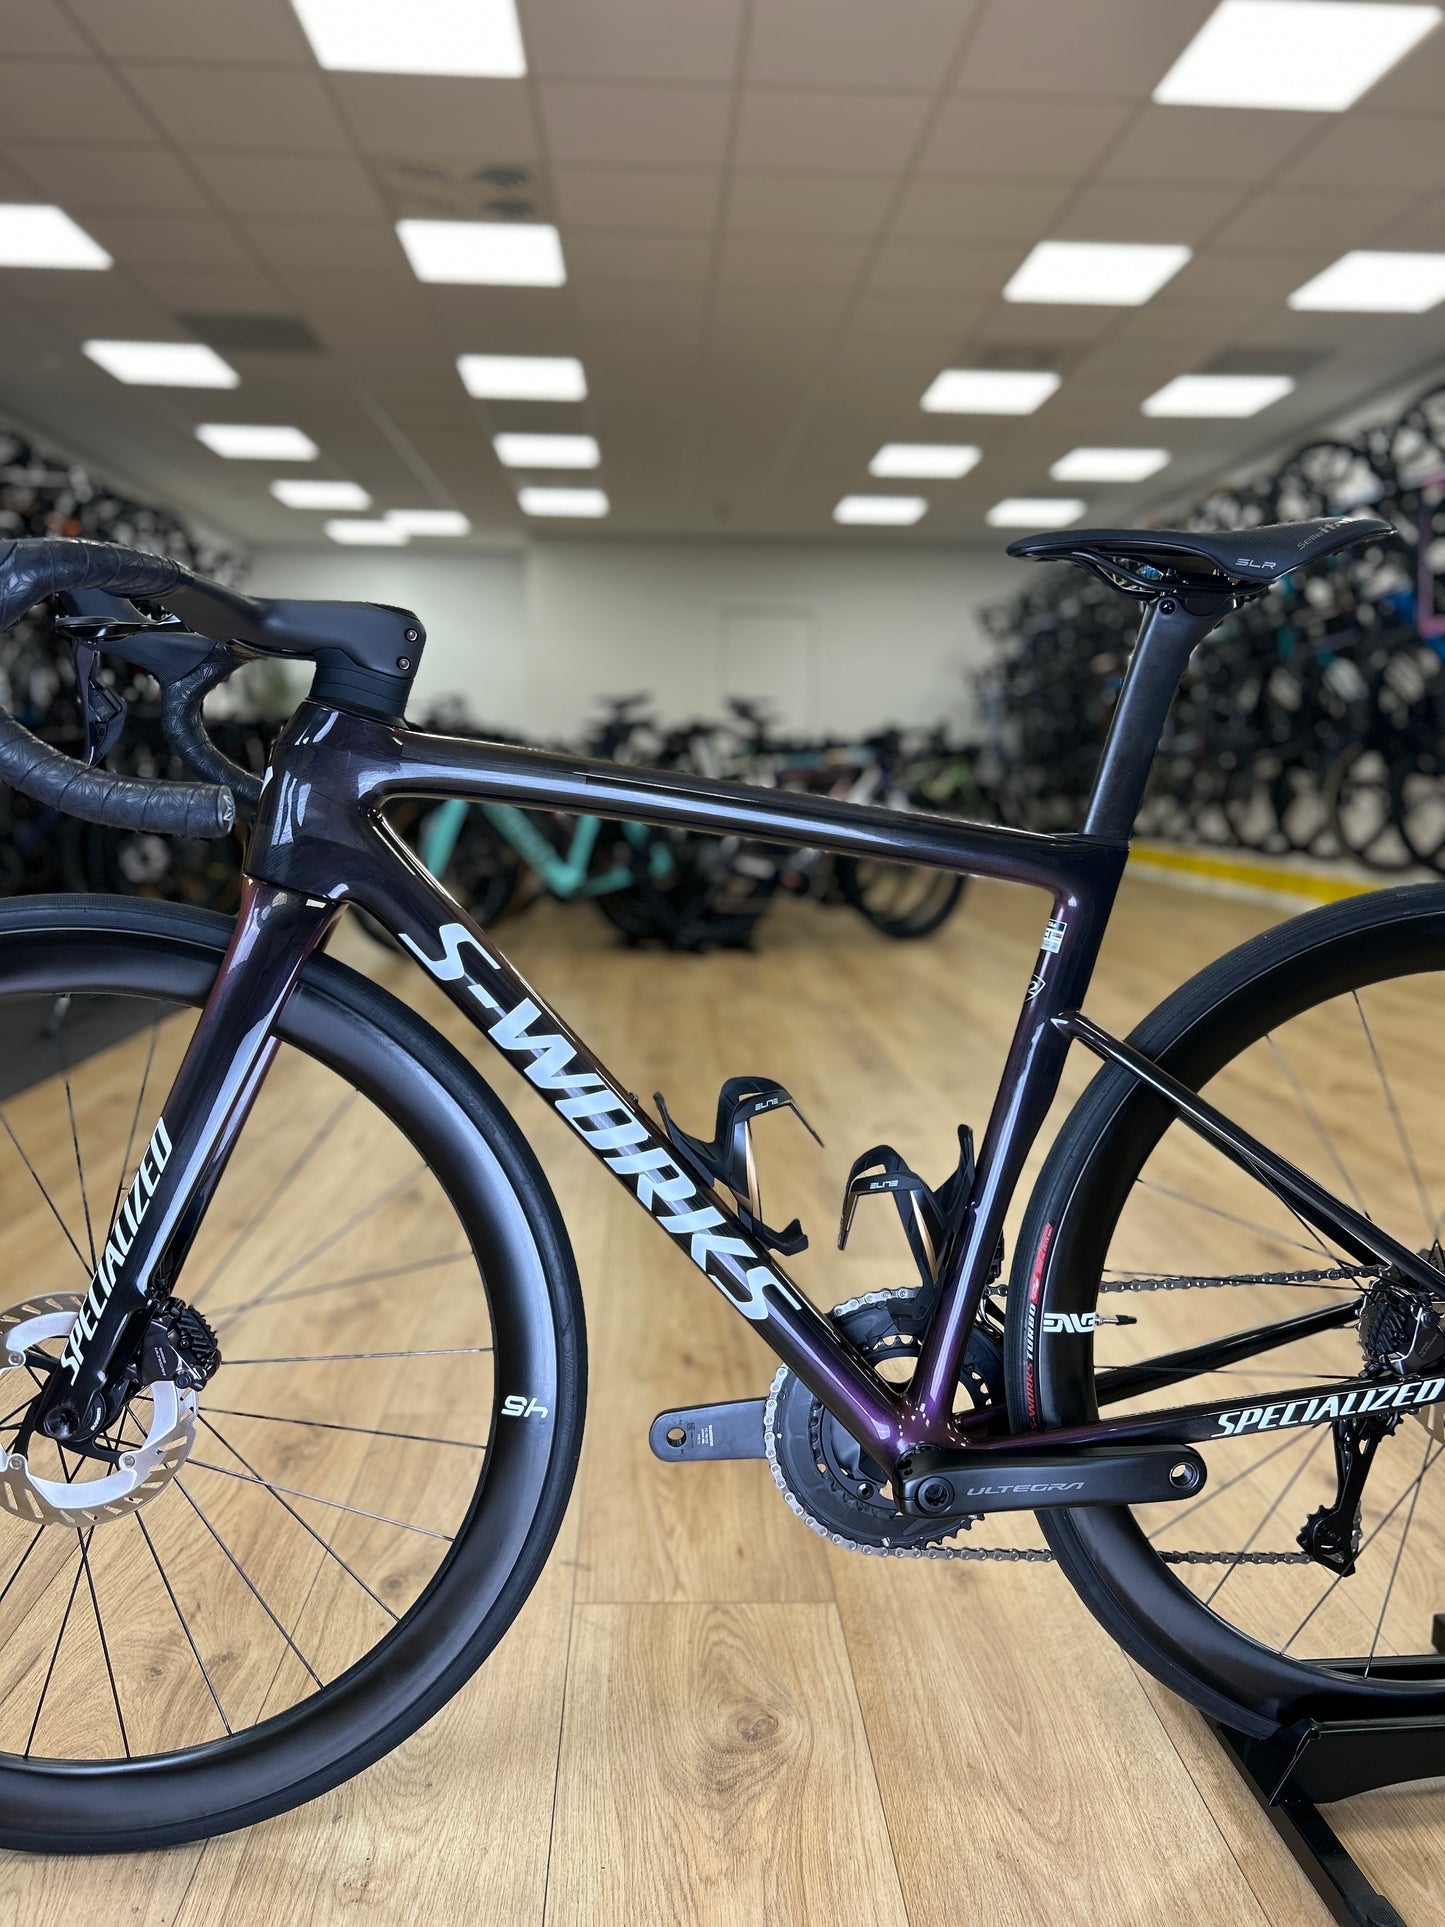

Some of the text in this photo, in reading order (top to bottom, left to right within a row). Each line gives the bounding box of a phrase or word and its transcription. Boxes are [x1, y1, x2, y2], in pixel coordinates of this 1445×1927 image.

[1235, 558, 1277, 570] SLR
[398, 923, 802, 1320] S-WORKS
[60, 1116, 173, 1386] SPECIALIZED
[1025, 1302, 1037, 1361] TURBO
[1024, 1362, 1037, 1430] S-WORKS
[1210, 1377, 1445, 1438] SPECIALIZED
[966, 1482, 1085, 1496] ULTEGRA
